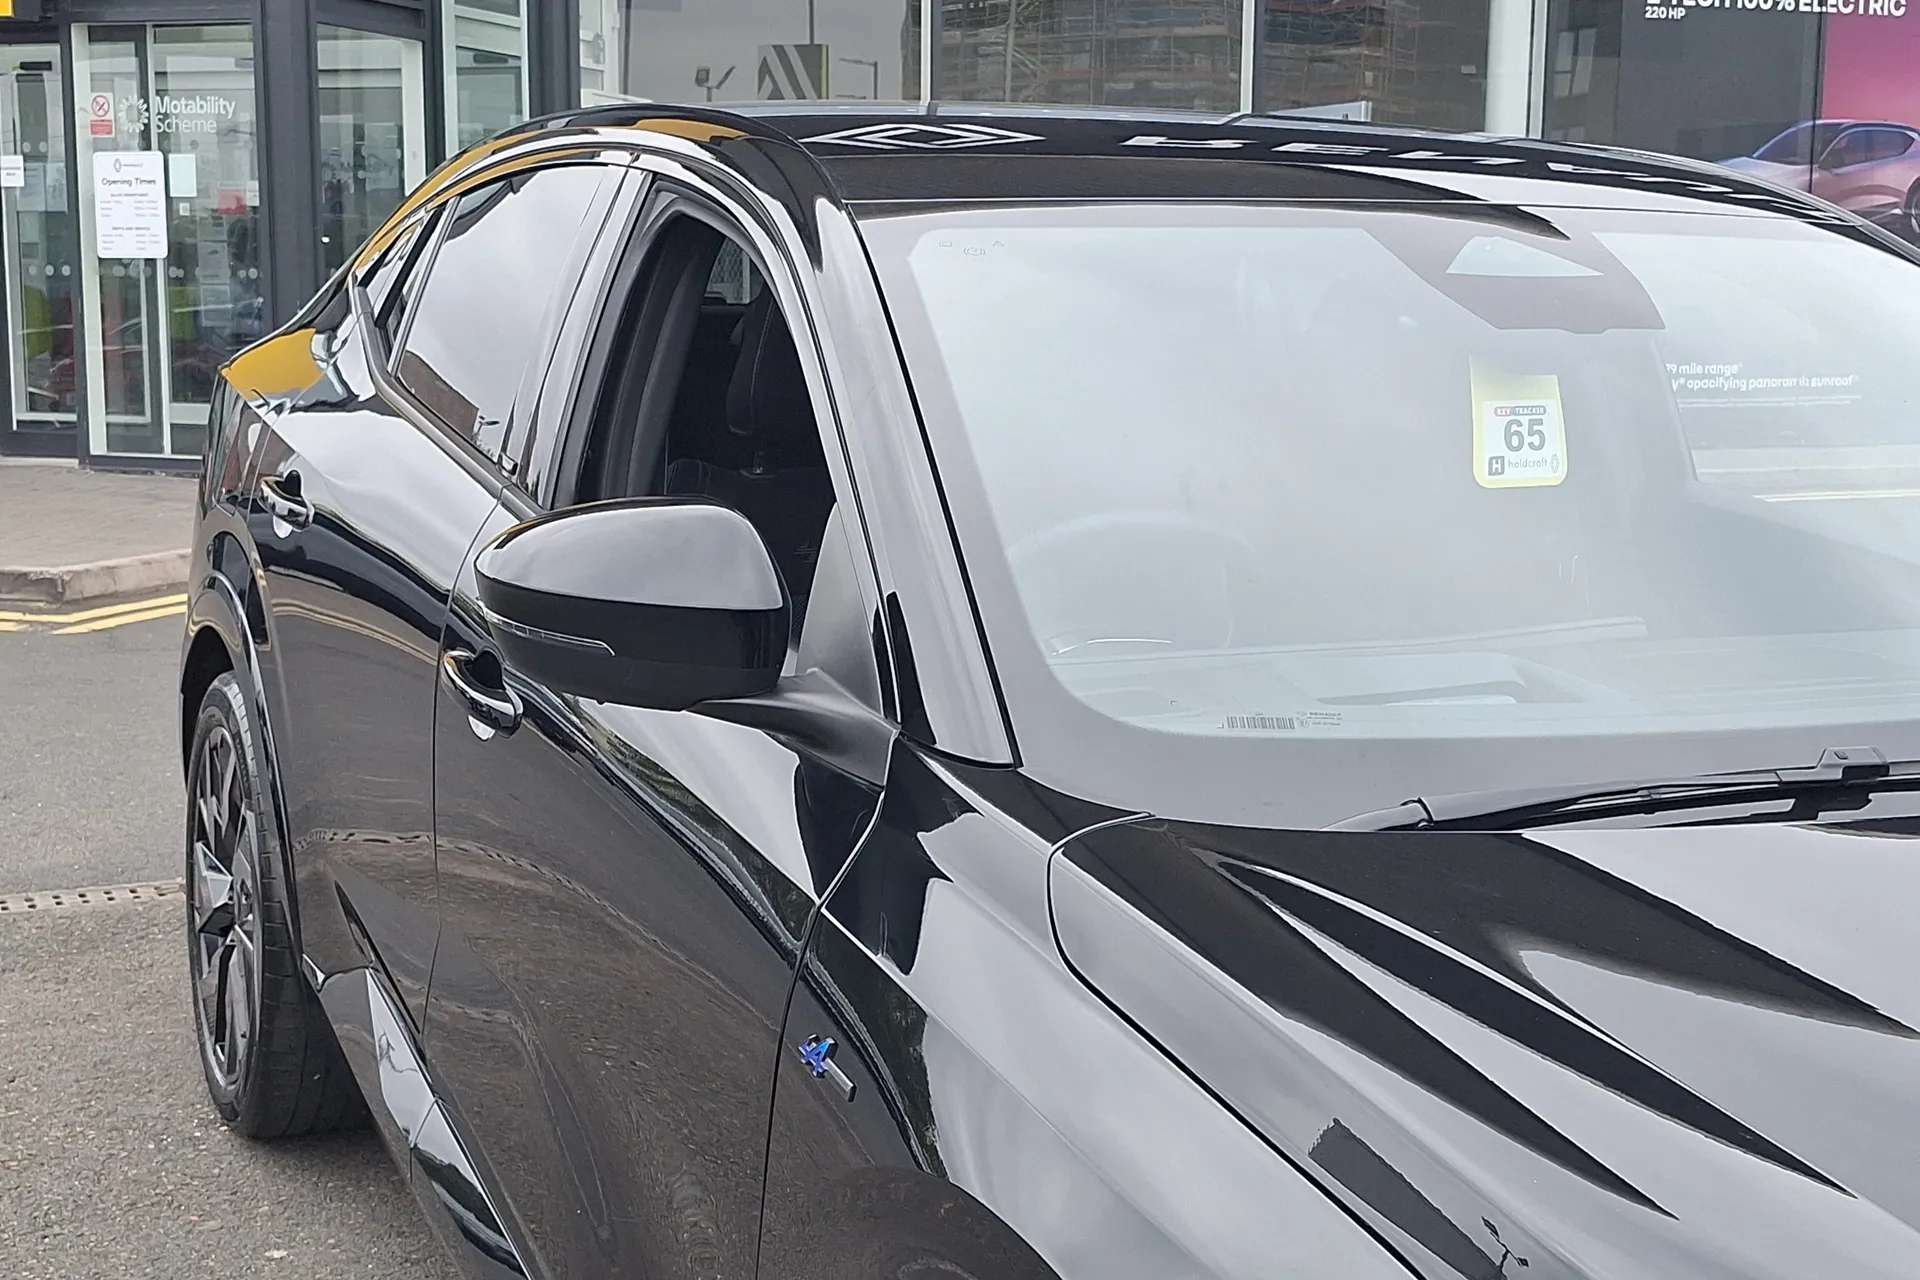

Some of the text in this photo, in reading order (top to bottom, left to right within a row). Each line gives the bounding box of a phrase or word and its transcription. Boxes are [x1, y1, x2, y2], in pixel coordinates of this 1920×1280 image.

[1645, 6, 1686, 19] 220 HP
[1798, 0, 1907, 16] ELECTRIC
[156, 95, 236, 118] Motability
[156, 115, 217, 133] Scheme
[101, 177, 157, 187] Opening Times
[1679, 362, 1703, 374] mile
[1503, 418, 1546, 452] 65
[1490, 457, 1503, 474] H
